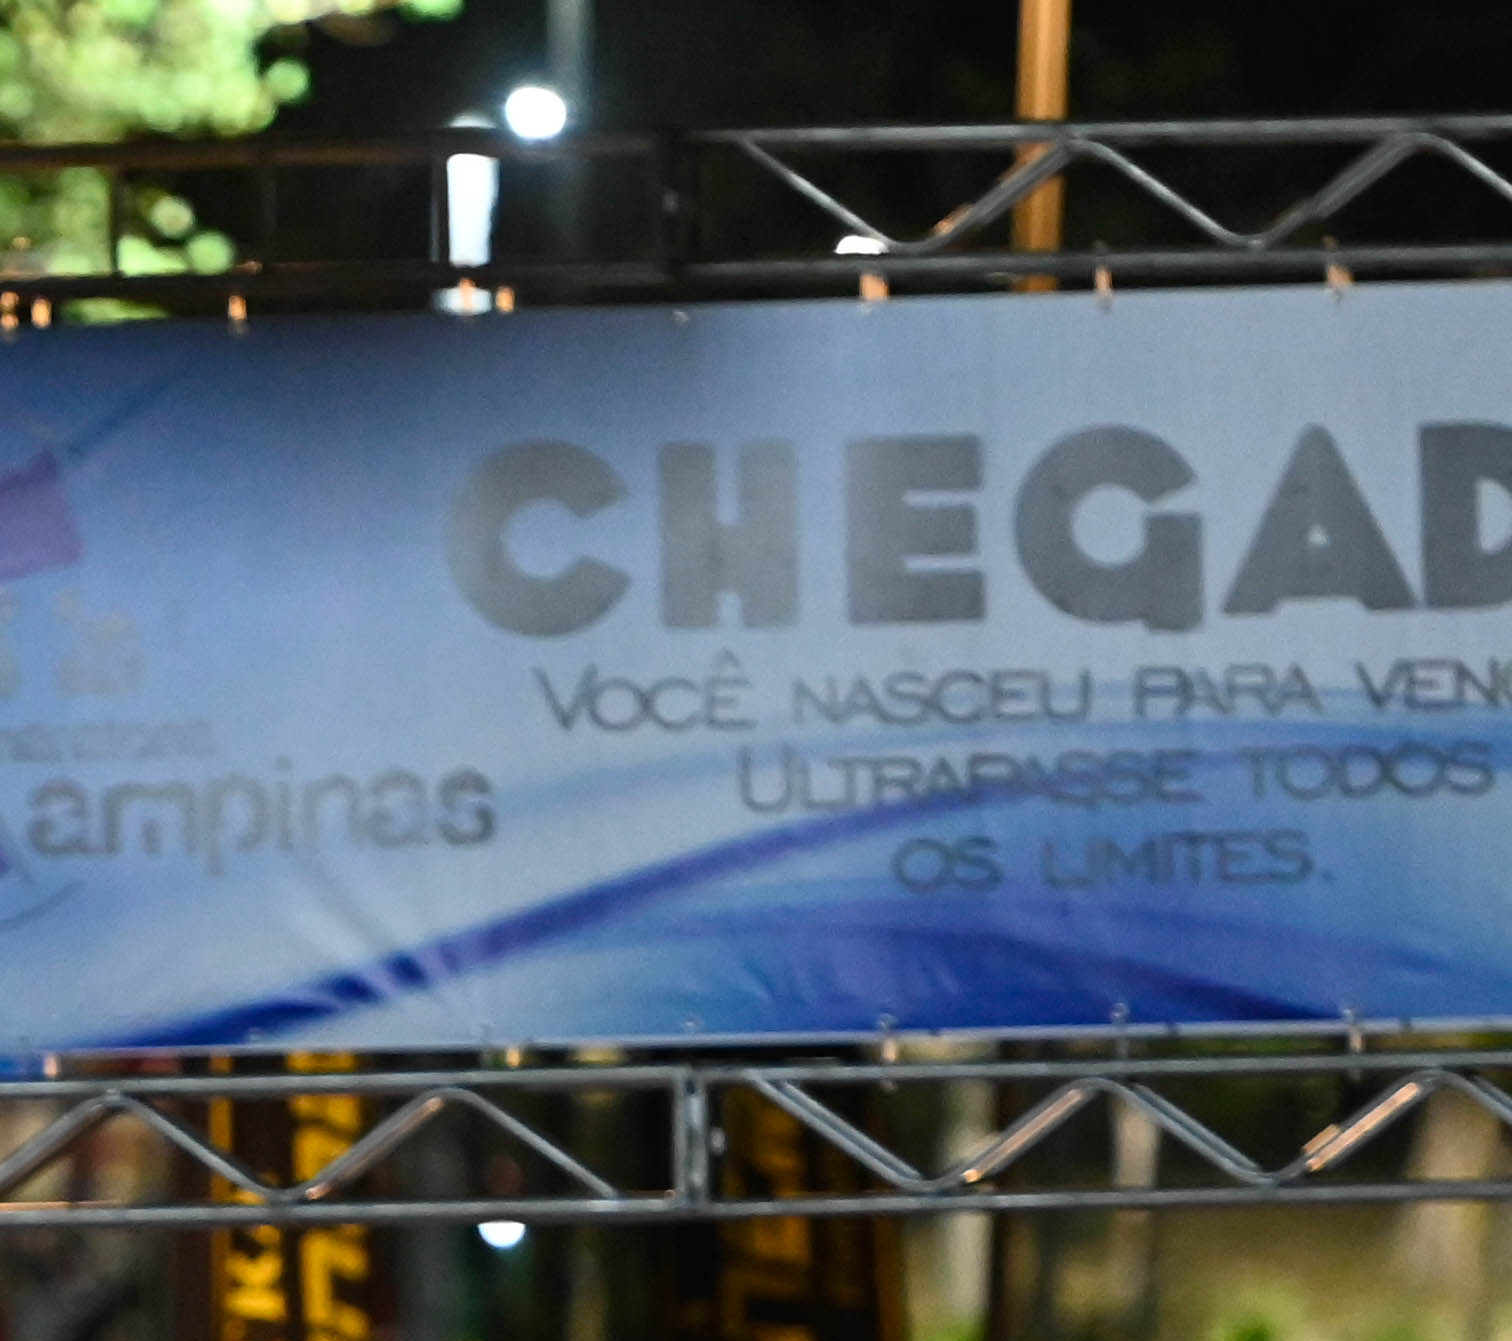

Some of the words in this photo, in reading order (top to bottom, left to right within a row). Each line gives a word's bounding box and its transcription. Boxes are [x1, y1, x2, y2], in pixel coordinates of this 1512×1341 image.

[531, 646, 758, 733] VOCÊ
[792, 664, 1090, 728] NASCEU
[1133, 660, 1324, 718] PARA
[734, 742, 1204, 815] ULTRAPASSE
[1237, 738, 1498, 801] TODOS
[890, 833, 1004, 895] OS
[1038, 828, 1334, 890] LIMITES.
